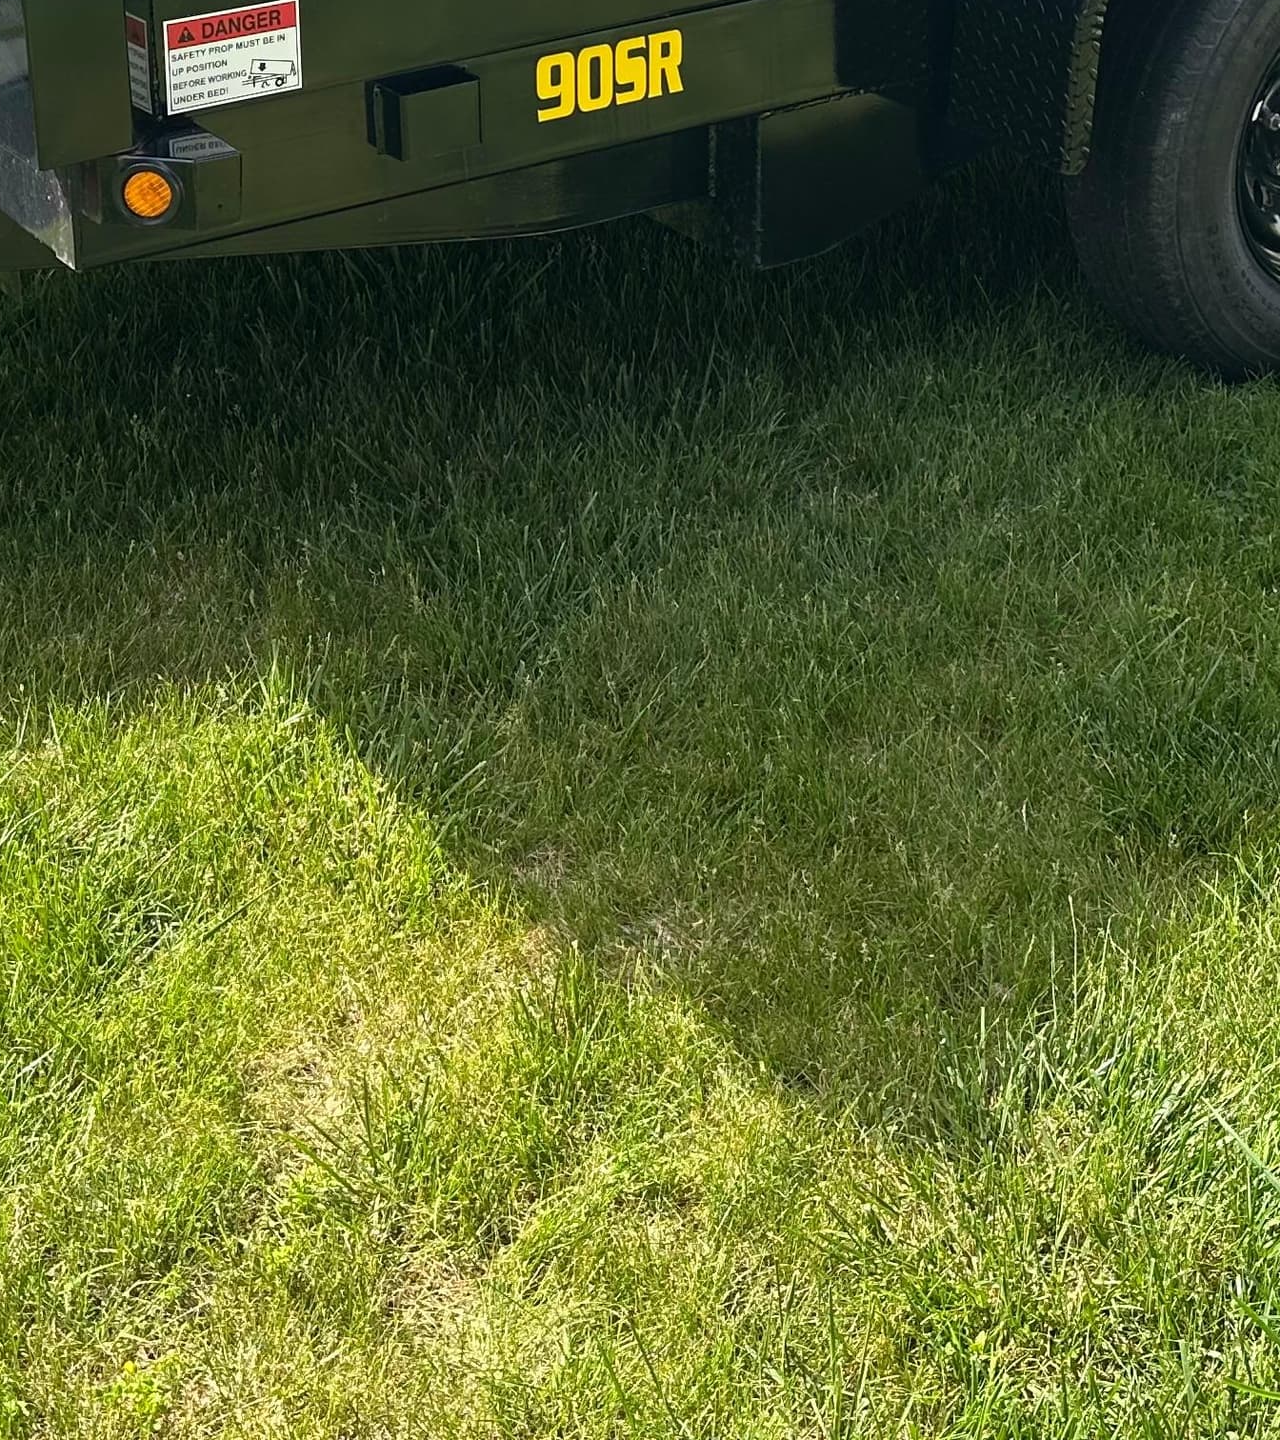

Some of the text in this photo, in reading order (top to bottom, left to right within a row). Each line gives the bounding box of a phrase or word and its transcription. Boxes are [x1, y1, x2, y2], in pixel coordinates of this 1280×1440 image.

[202, 9, 281, 39] DANGER
[171, 33, 286, 62] SAFETY PROP MUST BE IN
[172, 60, 228, 77] UP POSITION
[173, 70, 247, 91] BEFORE WORKING
[536, 29, 684, 123] 90SR
[174, 92, 204, 105] UNDER
